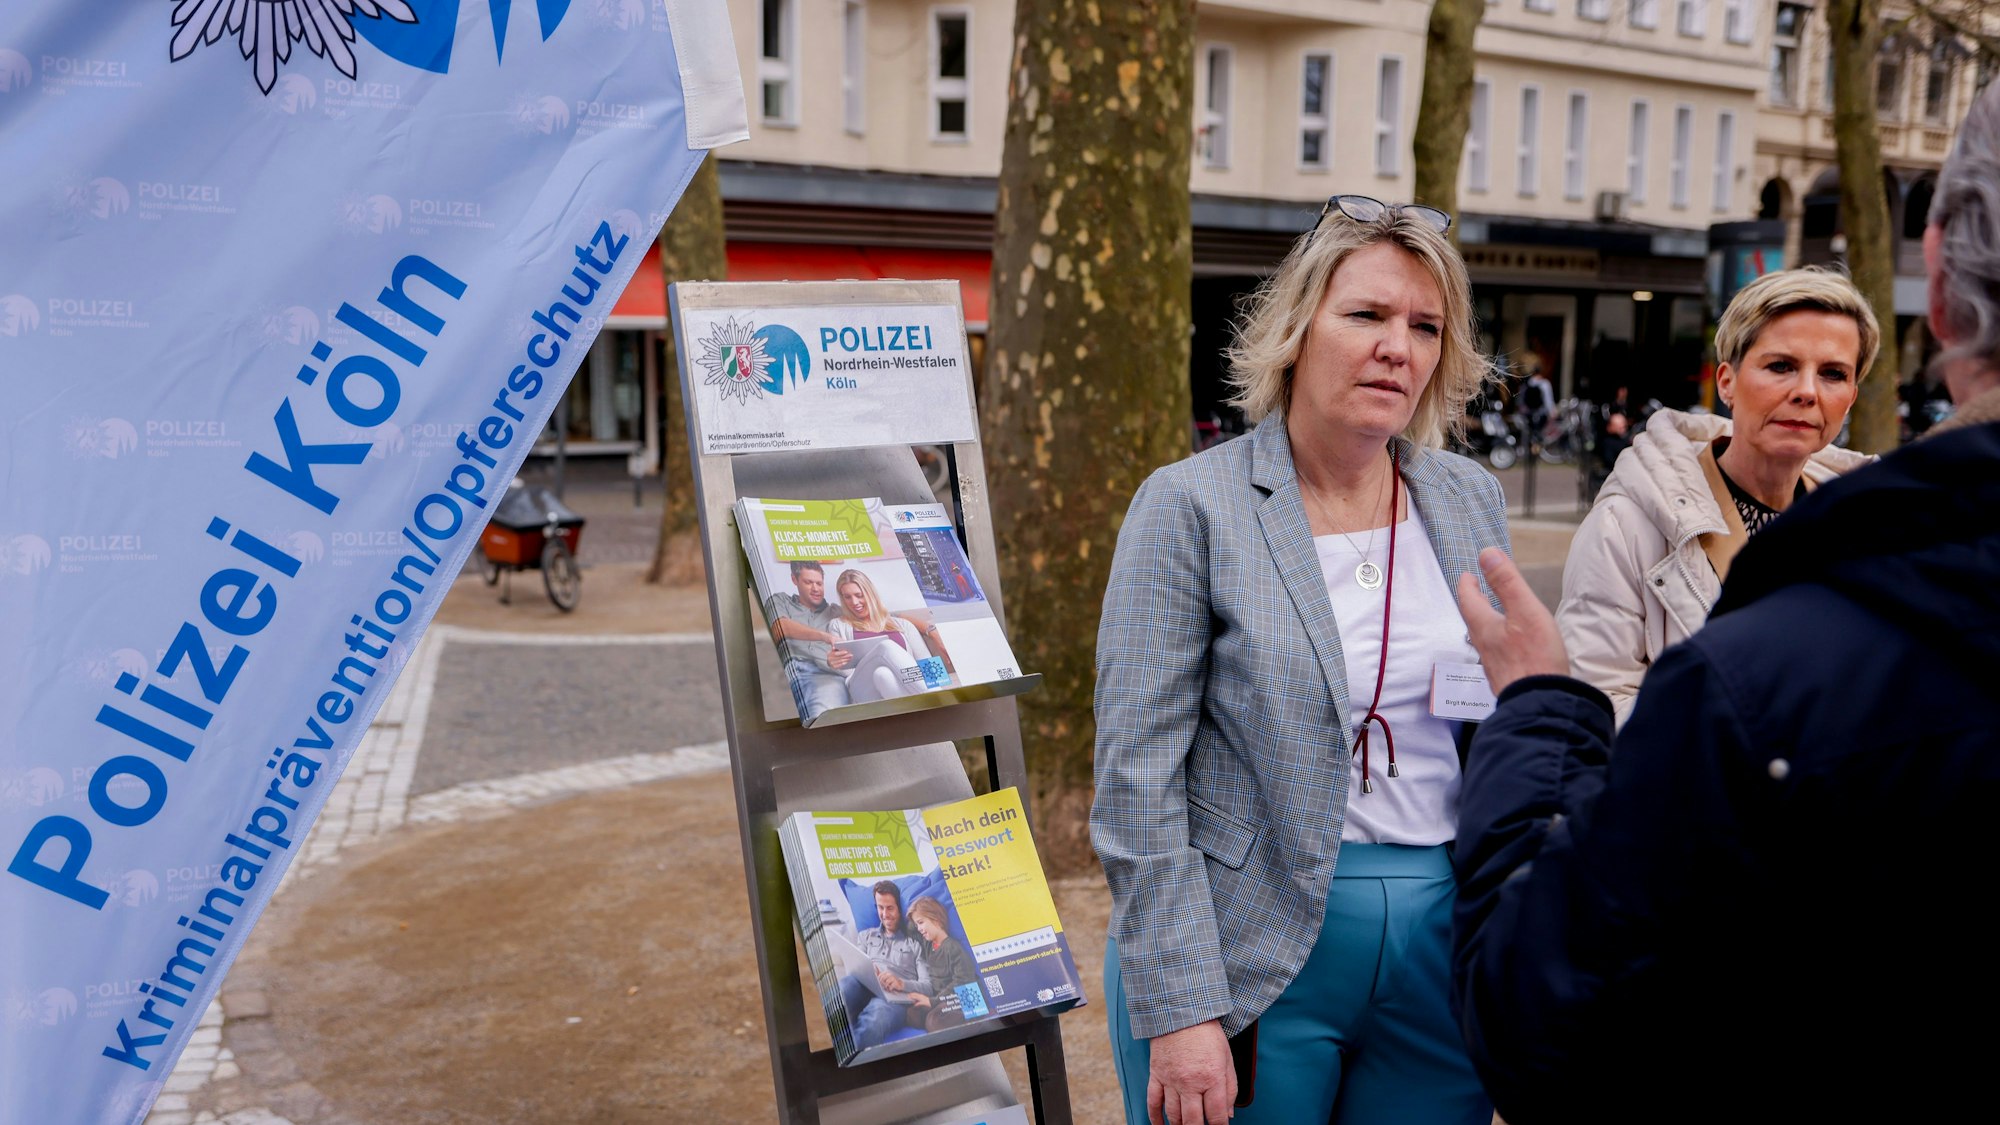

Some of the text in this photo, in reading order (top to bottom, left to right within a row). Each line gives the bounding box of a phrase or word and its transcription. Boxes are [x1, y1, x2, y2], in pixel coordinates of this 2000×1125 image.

[41, 55, 127, 77] POLIZEI
[324, 78, 401, 99] POLIZEI
[576, 100, 644, 120] POLIZEI
[138, 181, 220, 202] POLIZEI
[409, 199, 481, 217] POLIZEI
[48, 298, 133, 317] POLIZEI
[819, 325, 933, 353] POLIZEI
[823, 355, 957, 372] Nordrhein-Westfalen
[825, 376, 857, 390] Köln
[146, 420, 226, 436] POLIZEI
[411, 423, 479, 438] POLIZE
[708, 431, 785, 441] Kriminalkommissariat
[709, 439, 811, 451] Kriminalprävention/Opferschutz
[59, 535, 142, 552] POLIZEI
[331, 531, 404, 546] POLIZEI
[773, 530, 849, 543] KLICKS-MOMENTE
[778, 542, 873, 557] FÜR INTERNETNUTZER
[8, 255, 468, 911] Polizei Köln
[102, 221, 630, 1071] Kriminalprävention/Opferschutz
[1445, 699, 1490, 709] Birgit Wunderlich
[926, 807, 1018, 841] Mach dein
[824, 844, 891, 860] ONLINETIPPS FÜR
[933, 827, 1015, 860] Passwort
[167, 863, 223, 883] POLIZ
[828, 860, 898, 875] GROSS UND KLEIN
[943, 854, 992, 881] stark!
